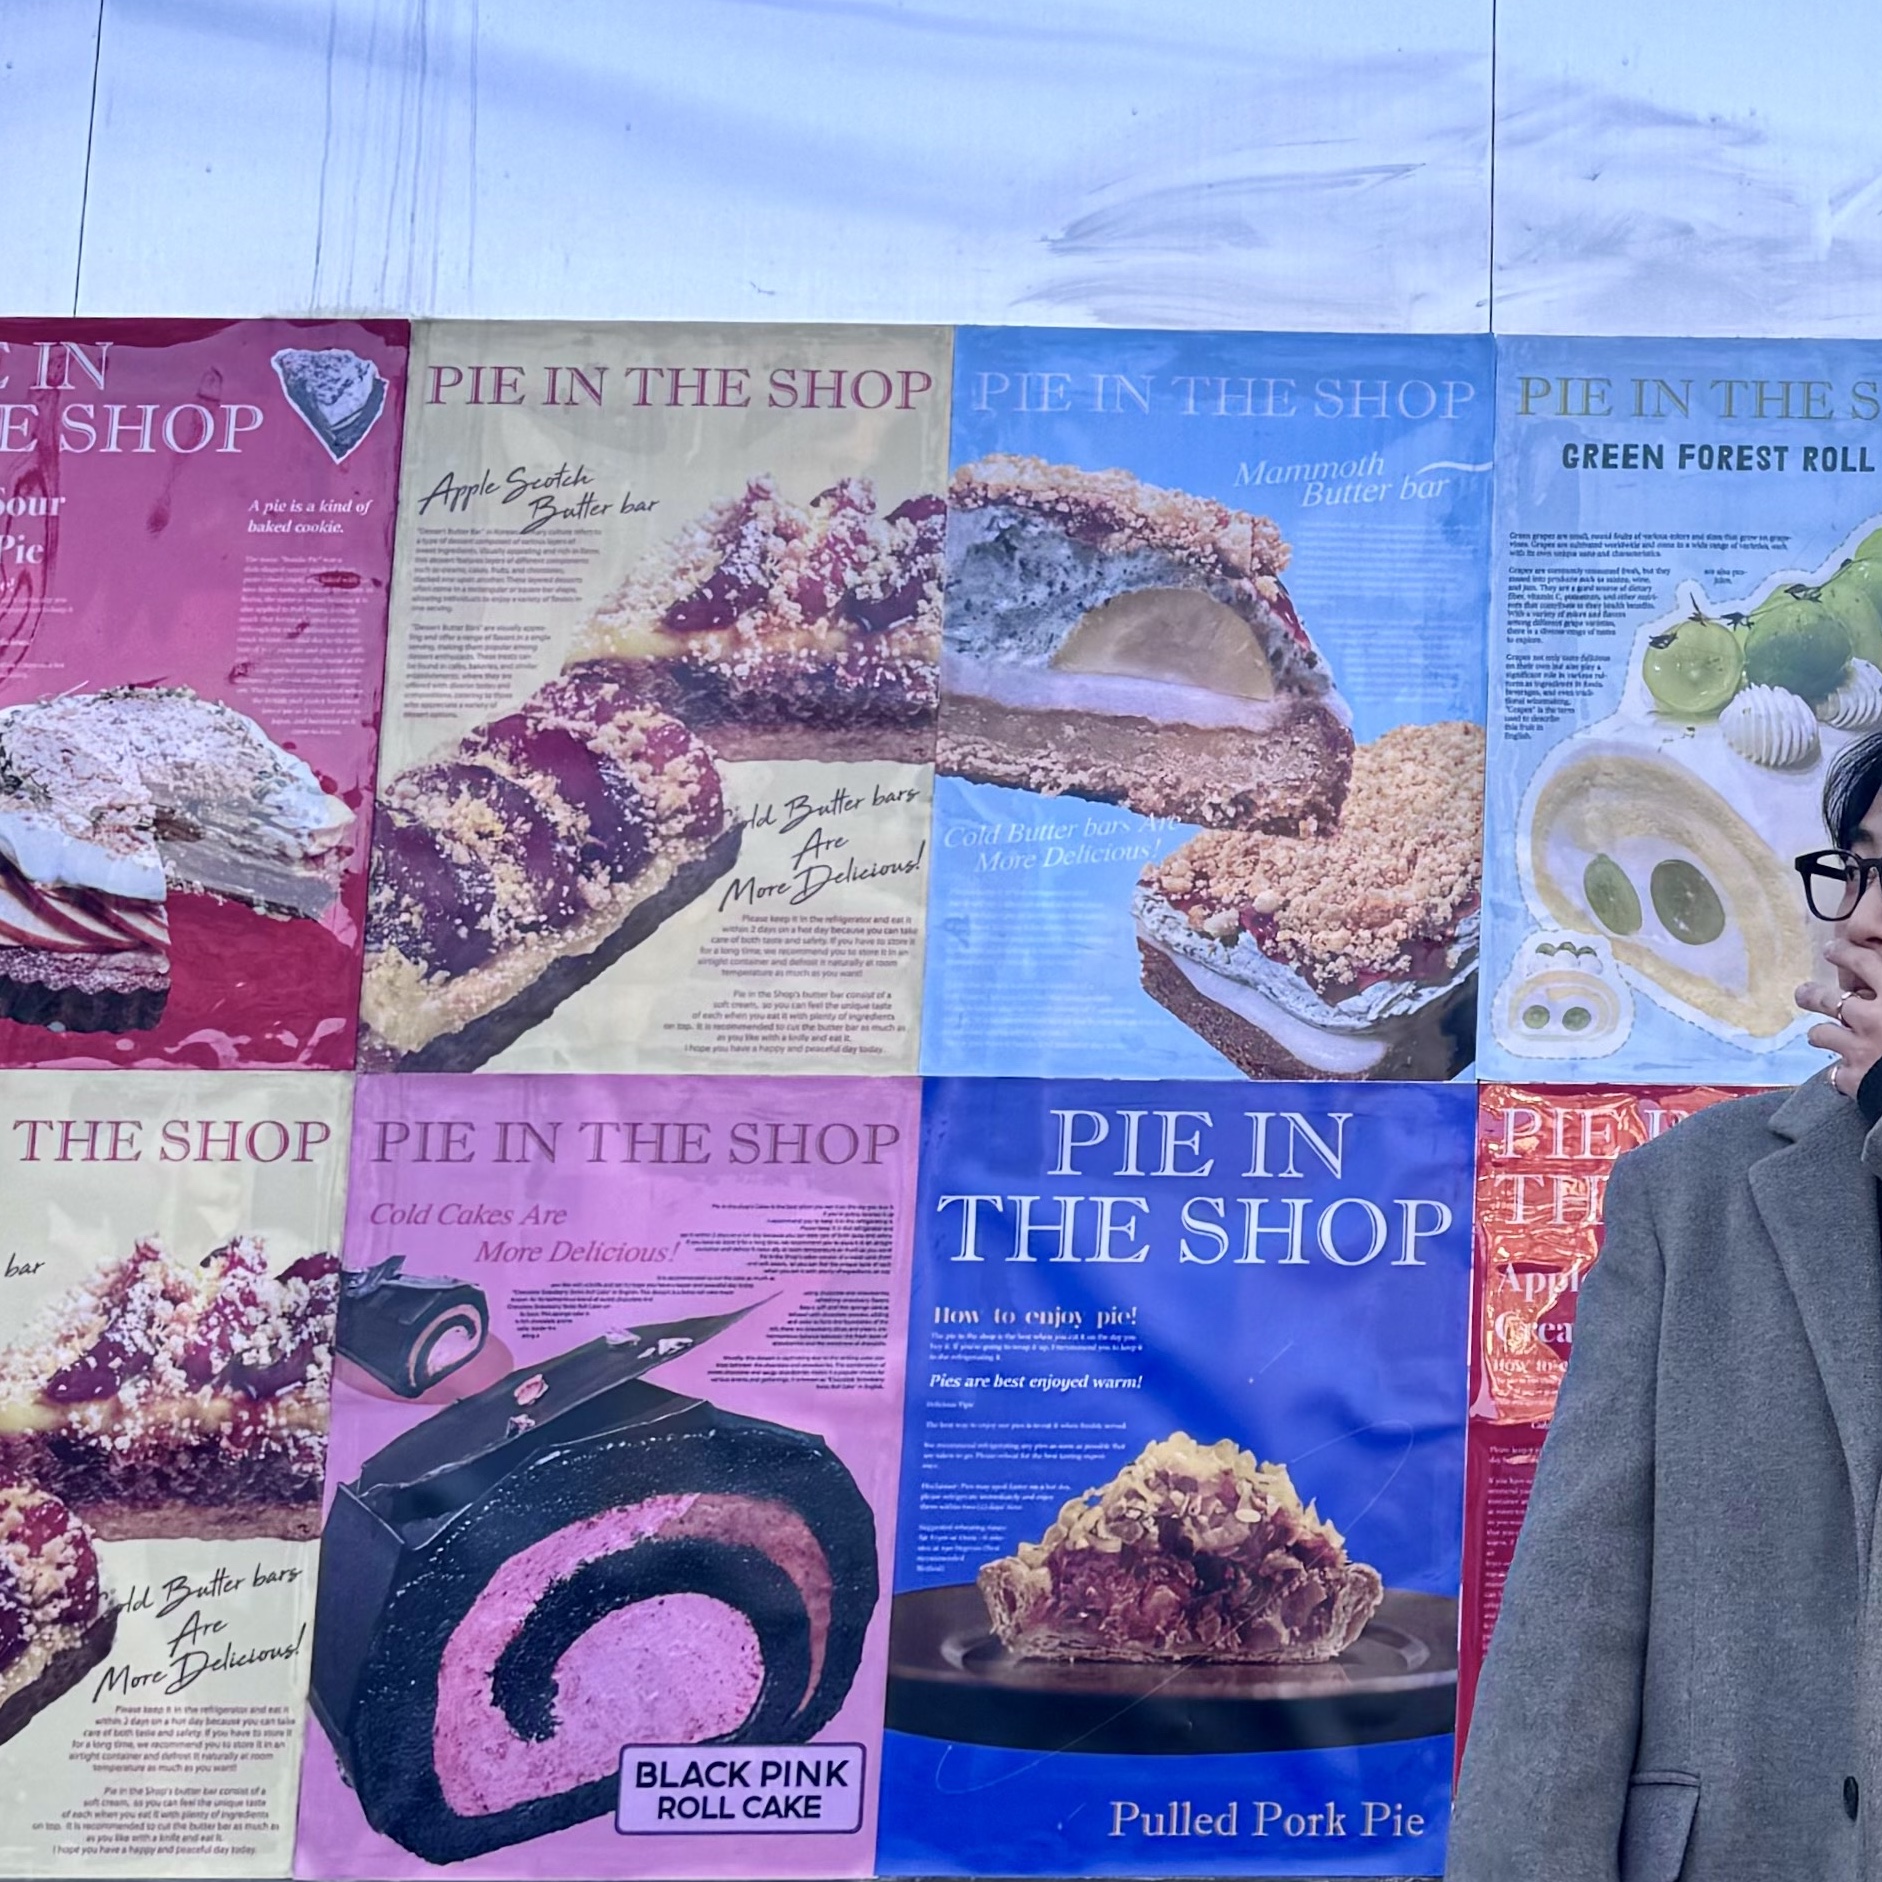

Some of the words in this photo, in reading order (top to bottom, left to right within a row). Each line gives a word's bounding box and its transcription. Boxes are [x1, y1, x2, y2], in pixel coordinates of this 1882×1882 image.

[30, 342, 113, 390] IN
[425, 364, 528, 406] PIE
[543, 366, 608, 407] IN
[625, 366, 751, 408] THE
[768, 368, 933, 410] SHOP
[973, 371, 1073, 413] PIE
[1090, 373, 1156, 416] IN
[1172, 374, 1298, 418] THE
[1314, 378, 1477, 421] SHOP
[1517, 376, 1613, 418] PIE
[1631, 378, 1694, 419] IN
[1710, 379, 1834, 421] THE
[59, 404, 264, 453] SHOP
[1233, 450, 1385, 489] Mammoth
[1561, 442, 1665, 472] GREEN
[1678, 443, 1790, 473] FOREST
[1803, 446, 1876, 474] ROLL
[248, 499, 260, 512] A
[262, 499, 289, 516] pie
[291, 499, 303, 513] is
[305, 502, 316, 513] a
[318, 499, 352, 513] kind
[355, 499, 374, 516] of
[418, 470, 500, 514] Apple
[501, 461, 595, 503] Scotch
[1301, 482, 1394, 509] Butter
[1399, 476, 1451, 501] bar
[247, 519, 291, 533] baked
[294, 519, 345, 534] cookie.
[521, 495, 613, 535] Butter
[620, 491, 661, 514] bar
[778, 793, 865, 835] Butter
[871, 783, 921, 806] bars
[792, 827, 849, 870] Are
[718, 876, 793, 913] More
[789, 840, 926, 906] Delicious!
[12, 1119, 143, 1161] THE
[159, 1119, 331, 1163] SHOP
[370, 1120, 476, 1164] PIE
[494, 1121, 563, 1165] IN
[578, 1121, 712, 1165] THE
[728, 1122, 901, 1166] SHOP
[1047, 1109, 1215, 1177] PIE
[1242, 1110, 1354, 1180] IN
[1495, 1108, 1622, 1159] PIE
[370, 1202, 434, 1226] Cold
[437, 1202, 517, 1226] Cakes
[518, 1203, 568, 1226] Are
[937, 1194, 1151, 1264] THE
[1179, 1196, 1453, 1267] SHOP
[474, 1240, 545, 1264] More
[548, 1240, 682, 1265] Delicious!
[934, 1307, 980, 1325] How
[993, 1308, 1016, 1325] to
[1025, 1306, 1083, 1329] enjoy
[1096, 1306, 1138, 1329] pie!
[929, 1373, 961, 1388] Pies
[964, 1376, 990, 1388] are
[993, 1374, 1025, 1388] best
[1029, 1374, 1089, 1392] enjoyed
[1092, 1375, 1143, 1389] warm!
[155, 1567, 245, 1618] Butter
[252, 1563, 303, 1587] bars
[167, 1610, 229, 1658] Are
[92, 1665, 167, 1703] More
[164, 1622, 306, 1694] Delicious!
[635, 1760, 752, 1788] BLACK
[760, 1760, 849, 1787] PINK
[657, 1795, 735, 1820] ROLL
[742, 1794, 822, 1819] CAKE
[1107, 1801, 1238, 1837] Pulled
[1251, 1801, 1347, 1837] Pork
[1360, 1801, 1425, 1837] Pie
